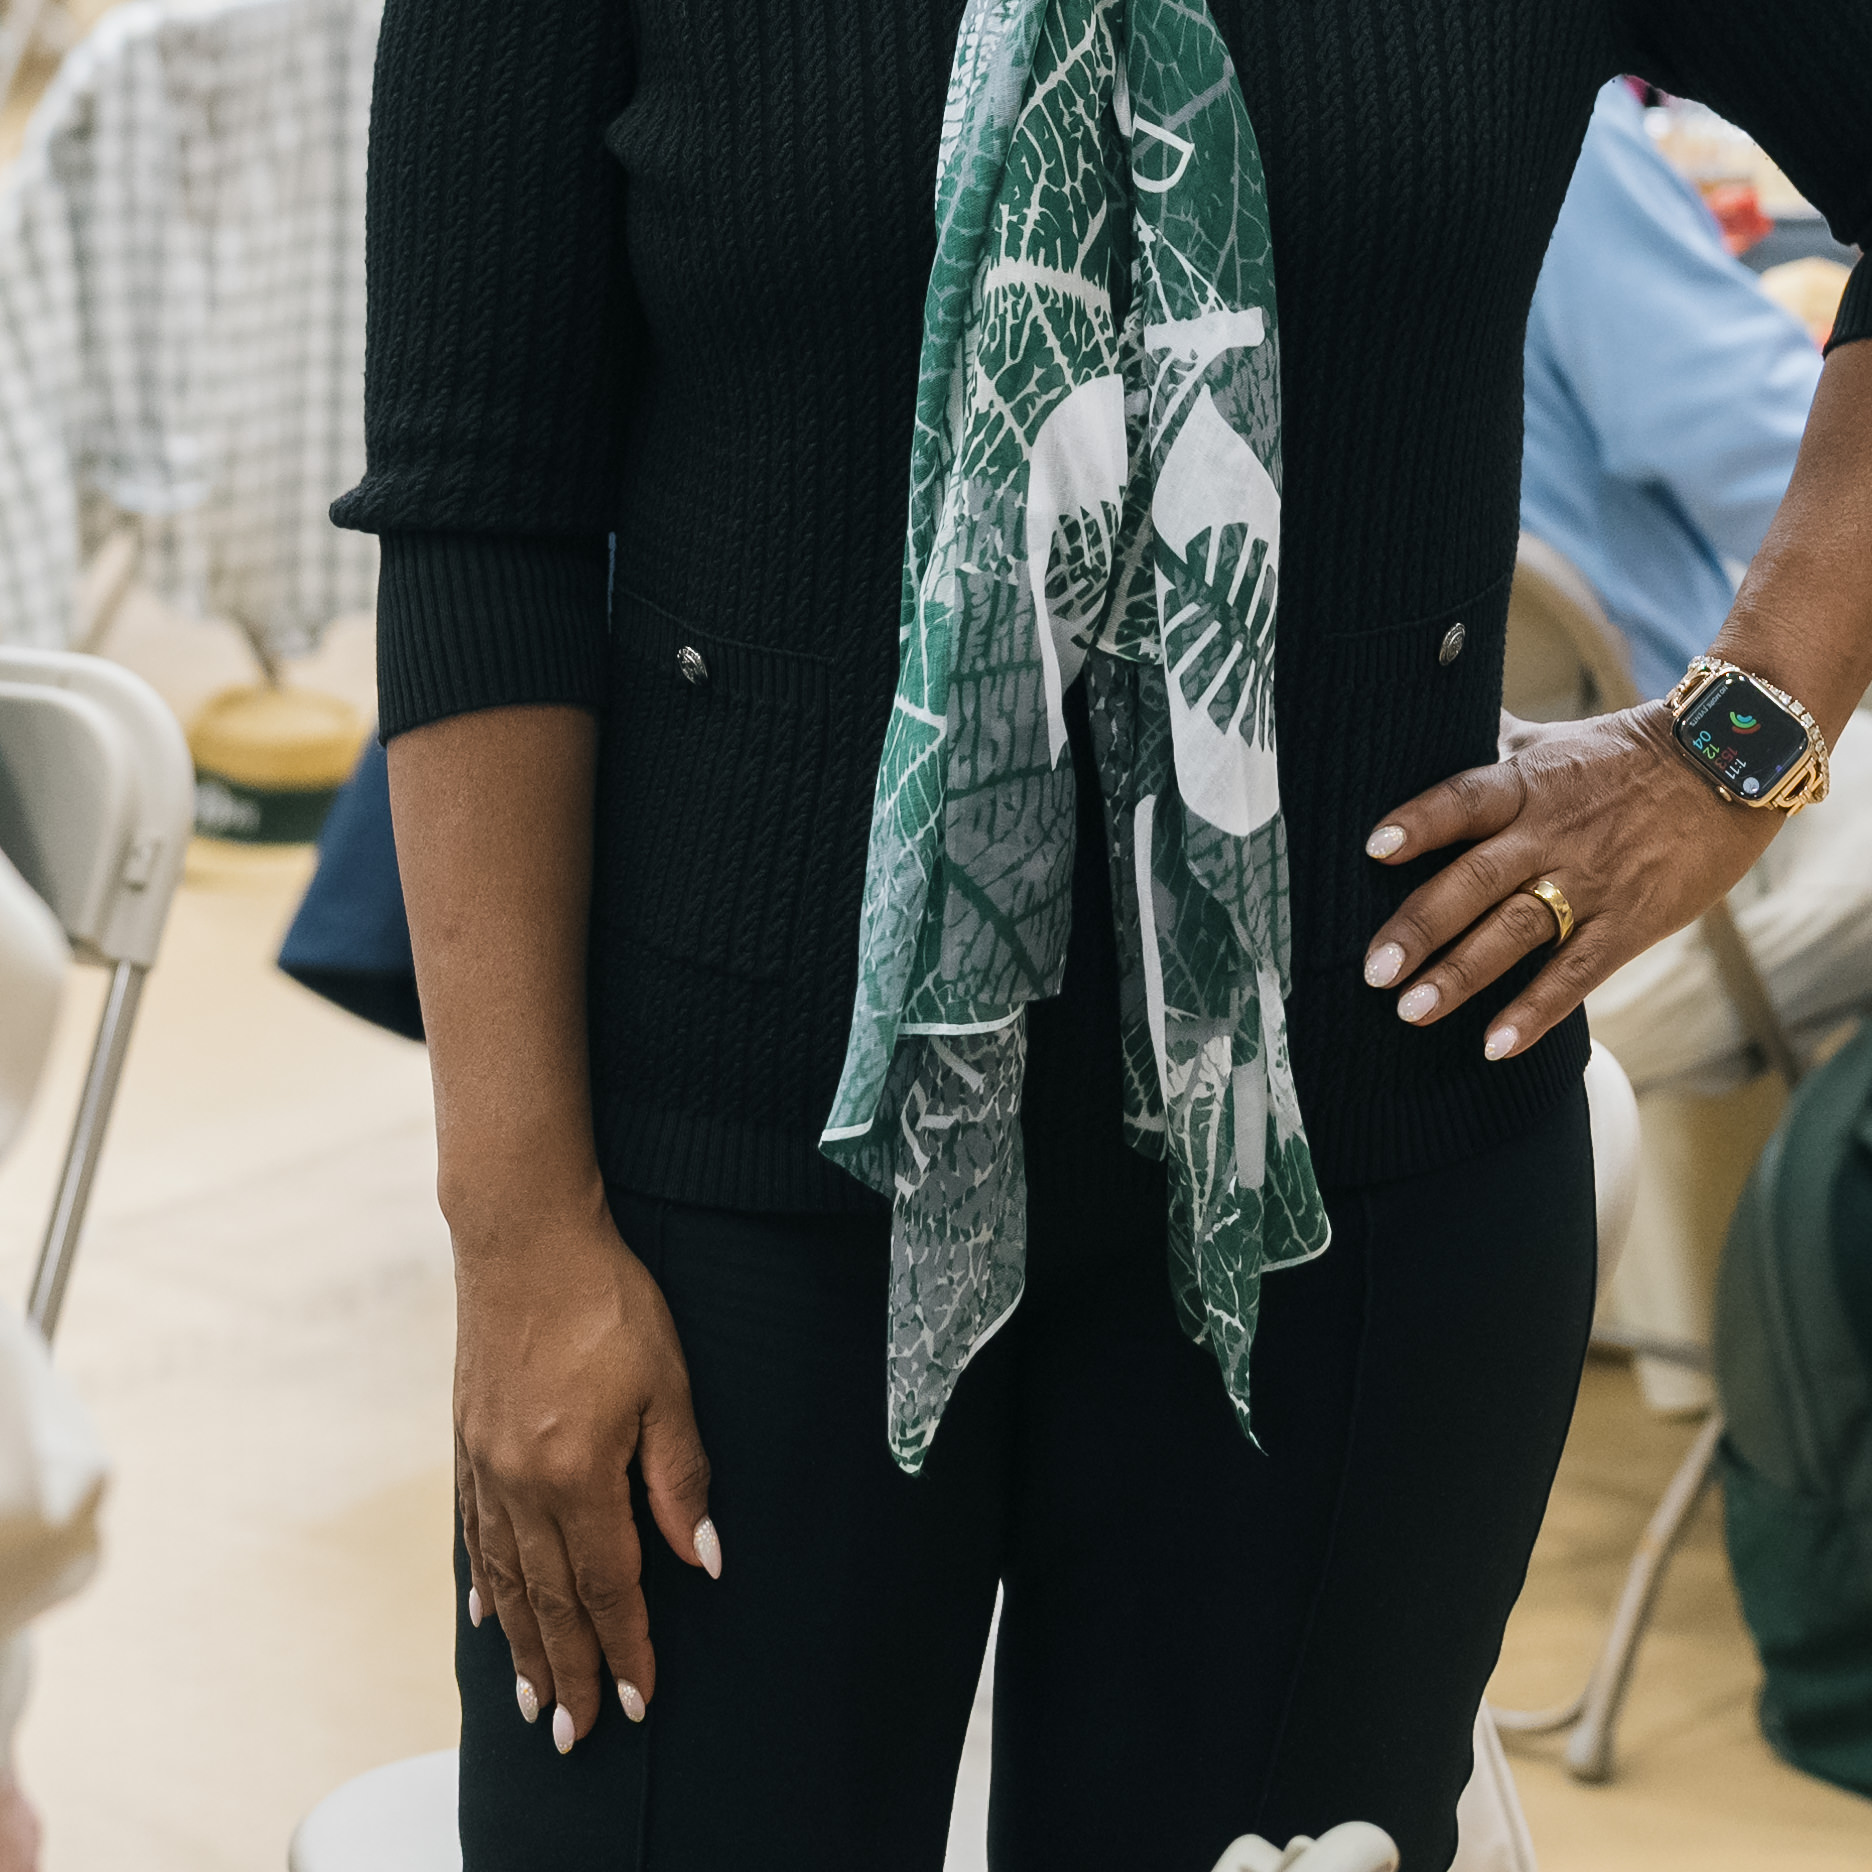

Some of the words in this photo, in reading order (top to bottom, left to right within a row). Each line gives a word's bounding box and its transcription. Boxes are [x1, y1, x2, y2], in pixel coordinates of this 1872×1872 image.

[1692, 731, 1711, 750] 04
[1702, 743, 1720, 760] 12
[1725, 758, 1746, 780] 1:11
